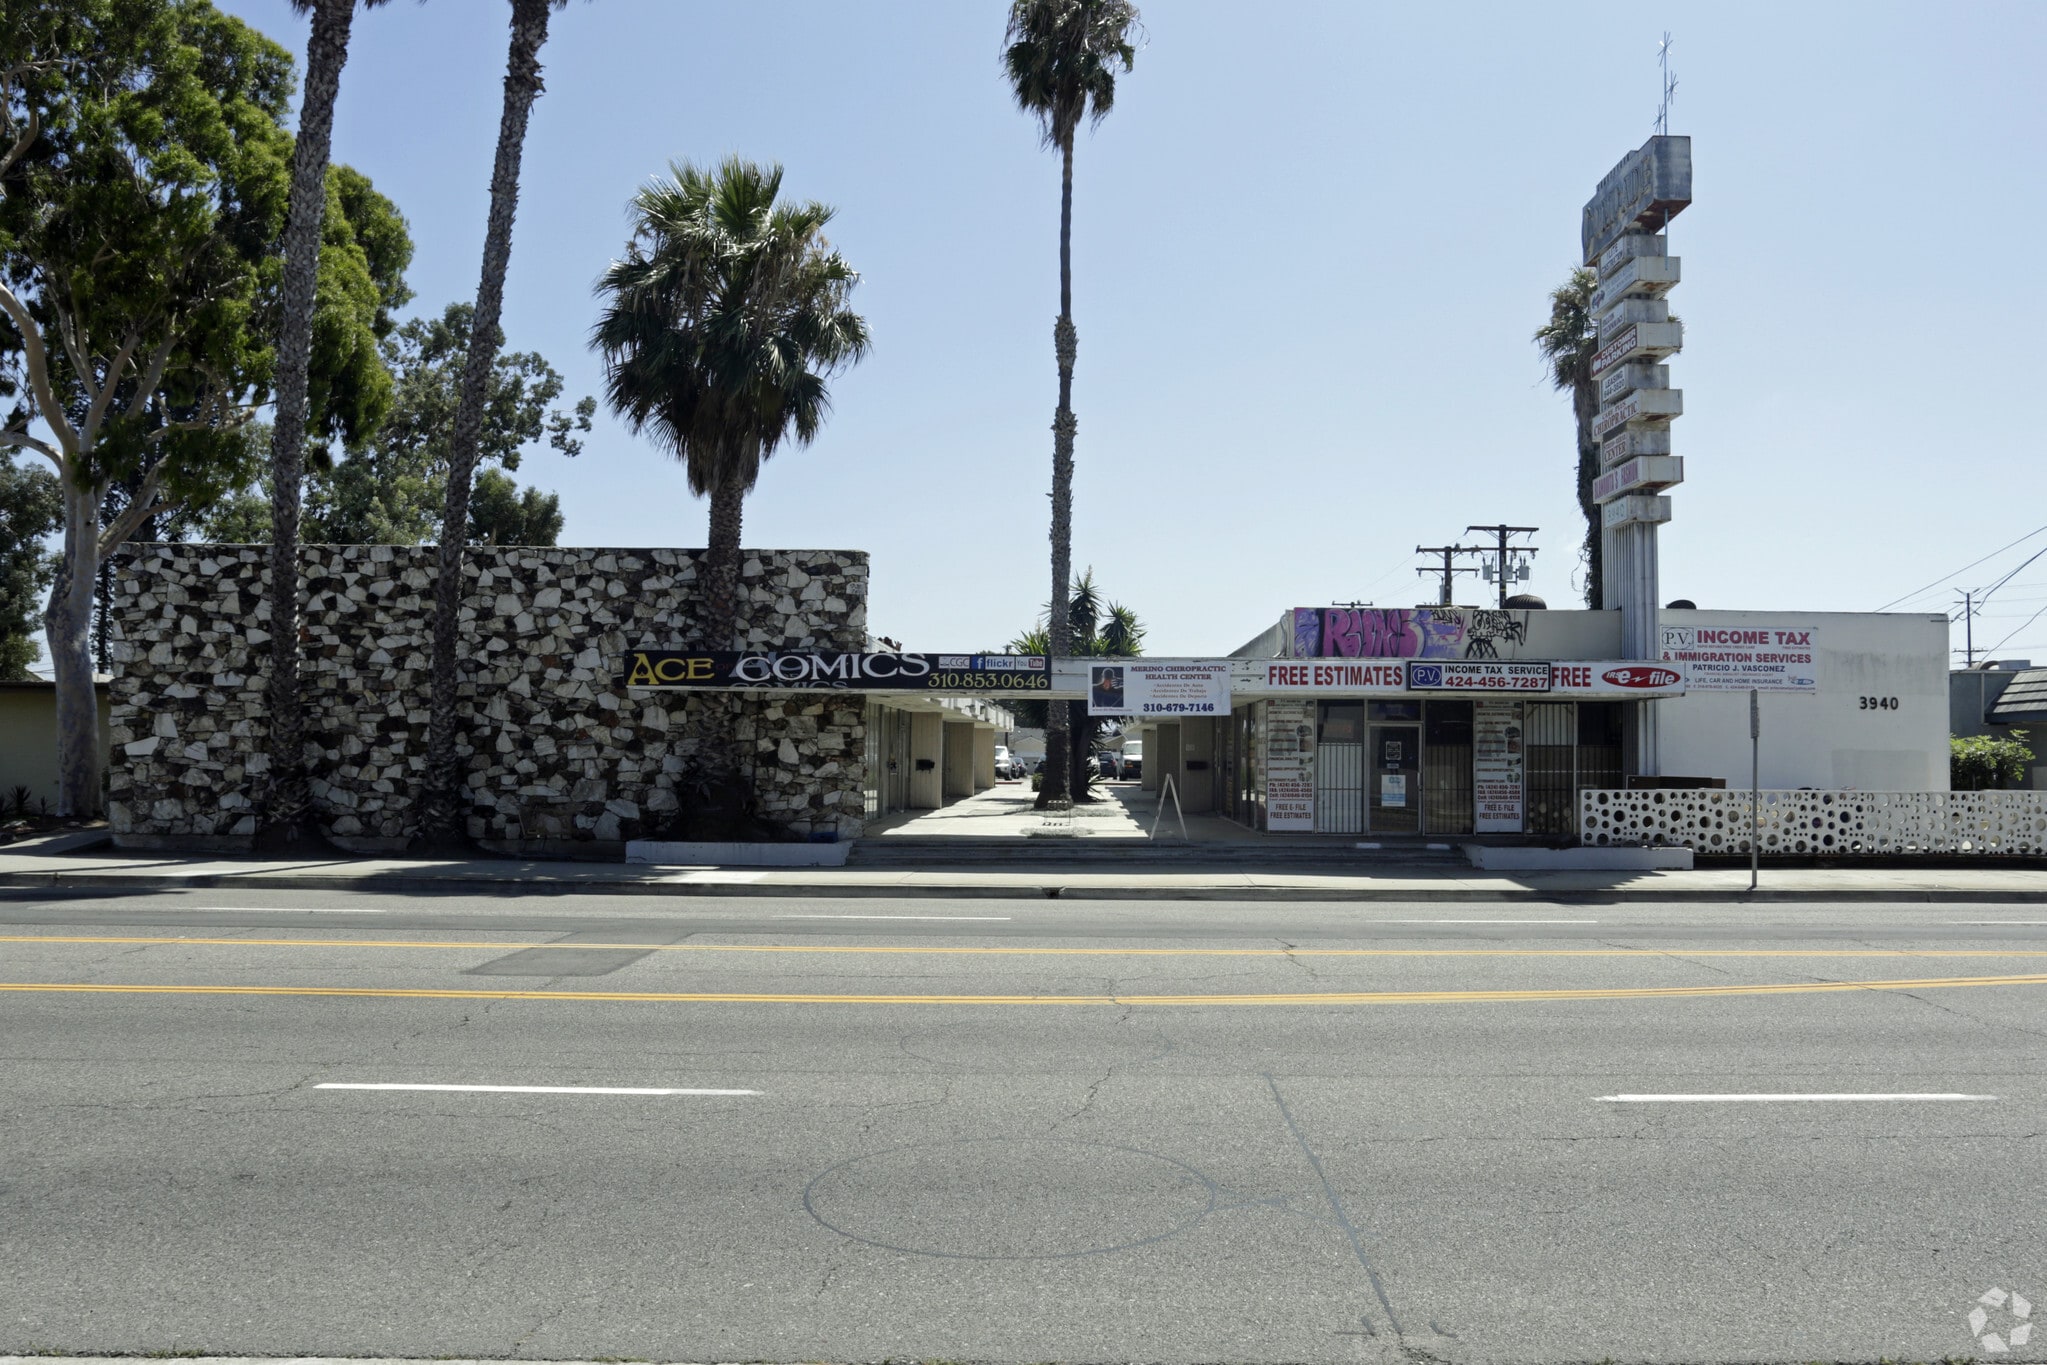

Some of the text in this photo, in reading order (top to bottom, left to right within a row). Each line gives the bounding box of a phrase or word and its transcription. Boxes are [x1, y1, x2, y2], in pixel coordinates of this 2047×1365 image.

[1601, 328, 1636, 358] CUSTOMER
[1601, 338, 1636, 368] PARKING
[1606, 371, 1624, 387] LEASING
[1594, 401, 1637, 437] CHIROPRACTIC
[1605, 442, 1626, 462] CENTER
[1666, 630, 1811, 646] P.V. INCOME TAX
[950, 657, 970, 666] CGC
[986, 657, 1014, 668] flickr
[1662, 651, 1811, 664] & IMMIGRATION SERVICES
[628, 653, 714, 685] ACE
[736, 653, 930, 682] COMICS
[1268, 665, 1403, 686] FREE ESTIMATES
[1417, 665, 1548, 682] P.V. INCOME TAX SERVICE
[1606, 671, 1619, 679] IRS
[1693, 664, 1785, 672] PATRICIO J. VASCONEZ
[1445, 676, 1548, 688] 424-456-7287
[1552, 667, 1591, 687] FREE
[1143, 703, 1214, 712] 310-679-7146
[1858, 696, 1899, 710] 3940
